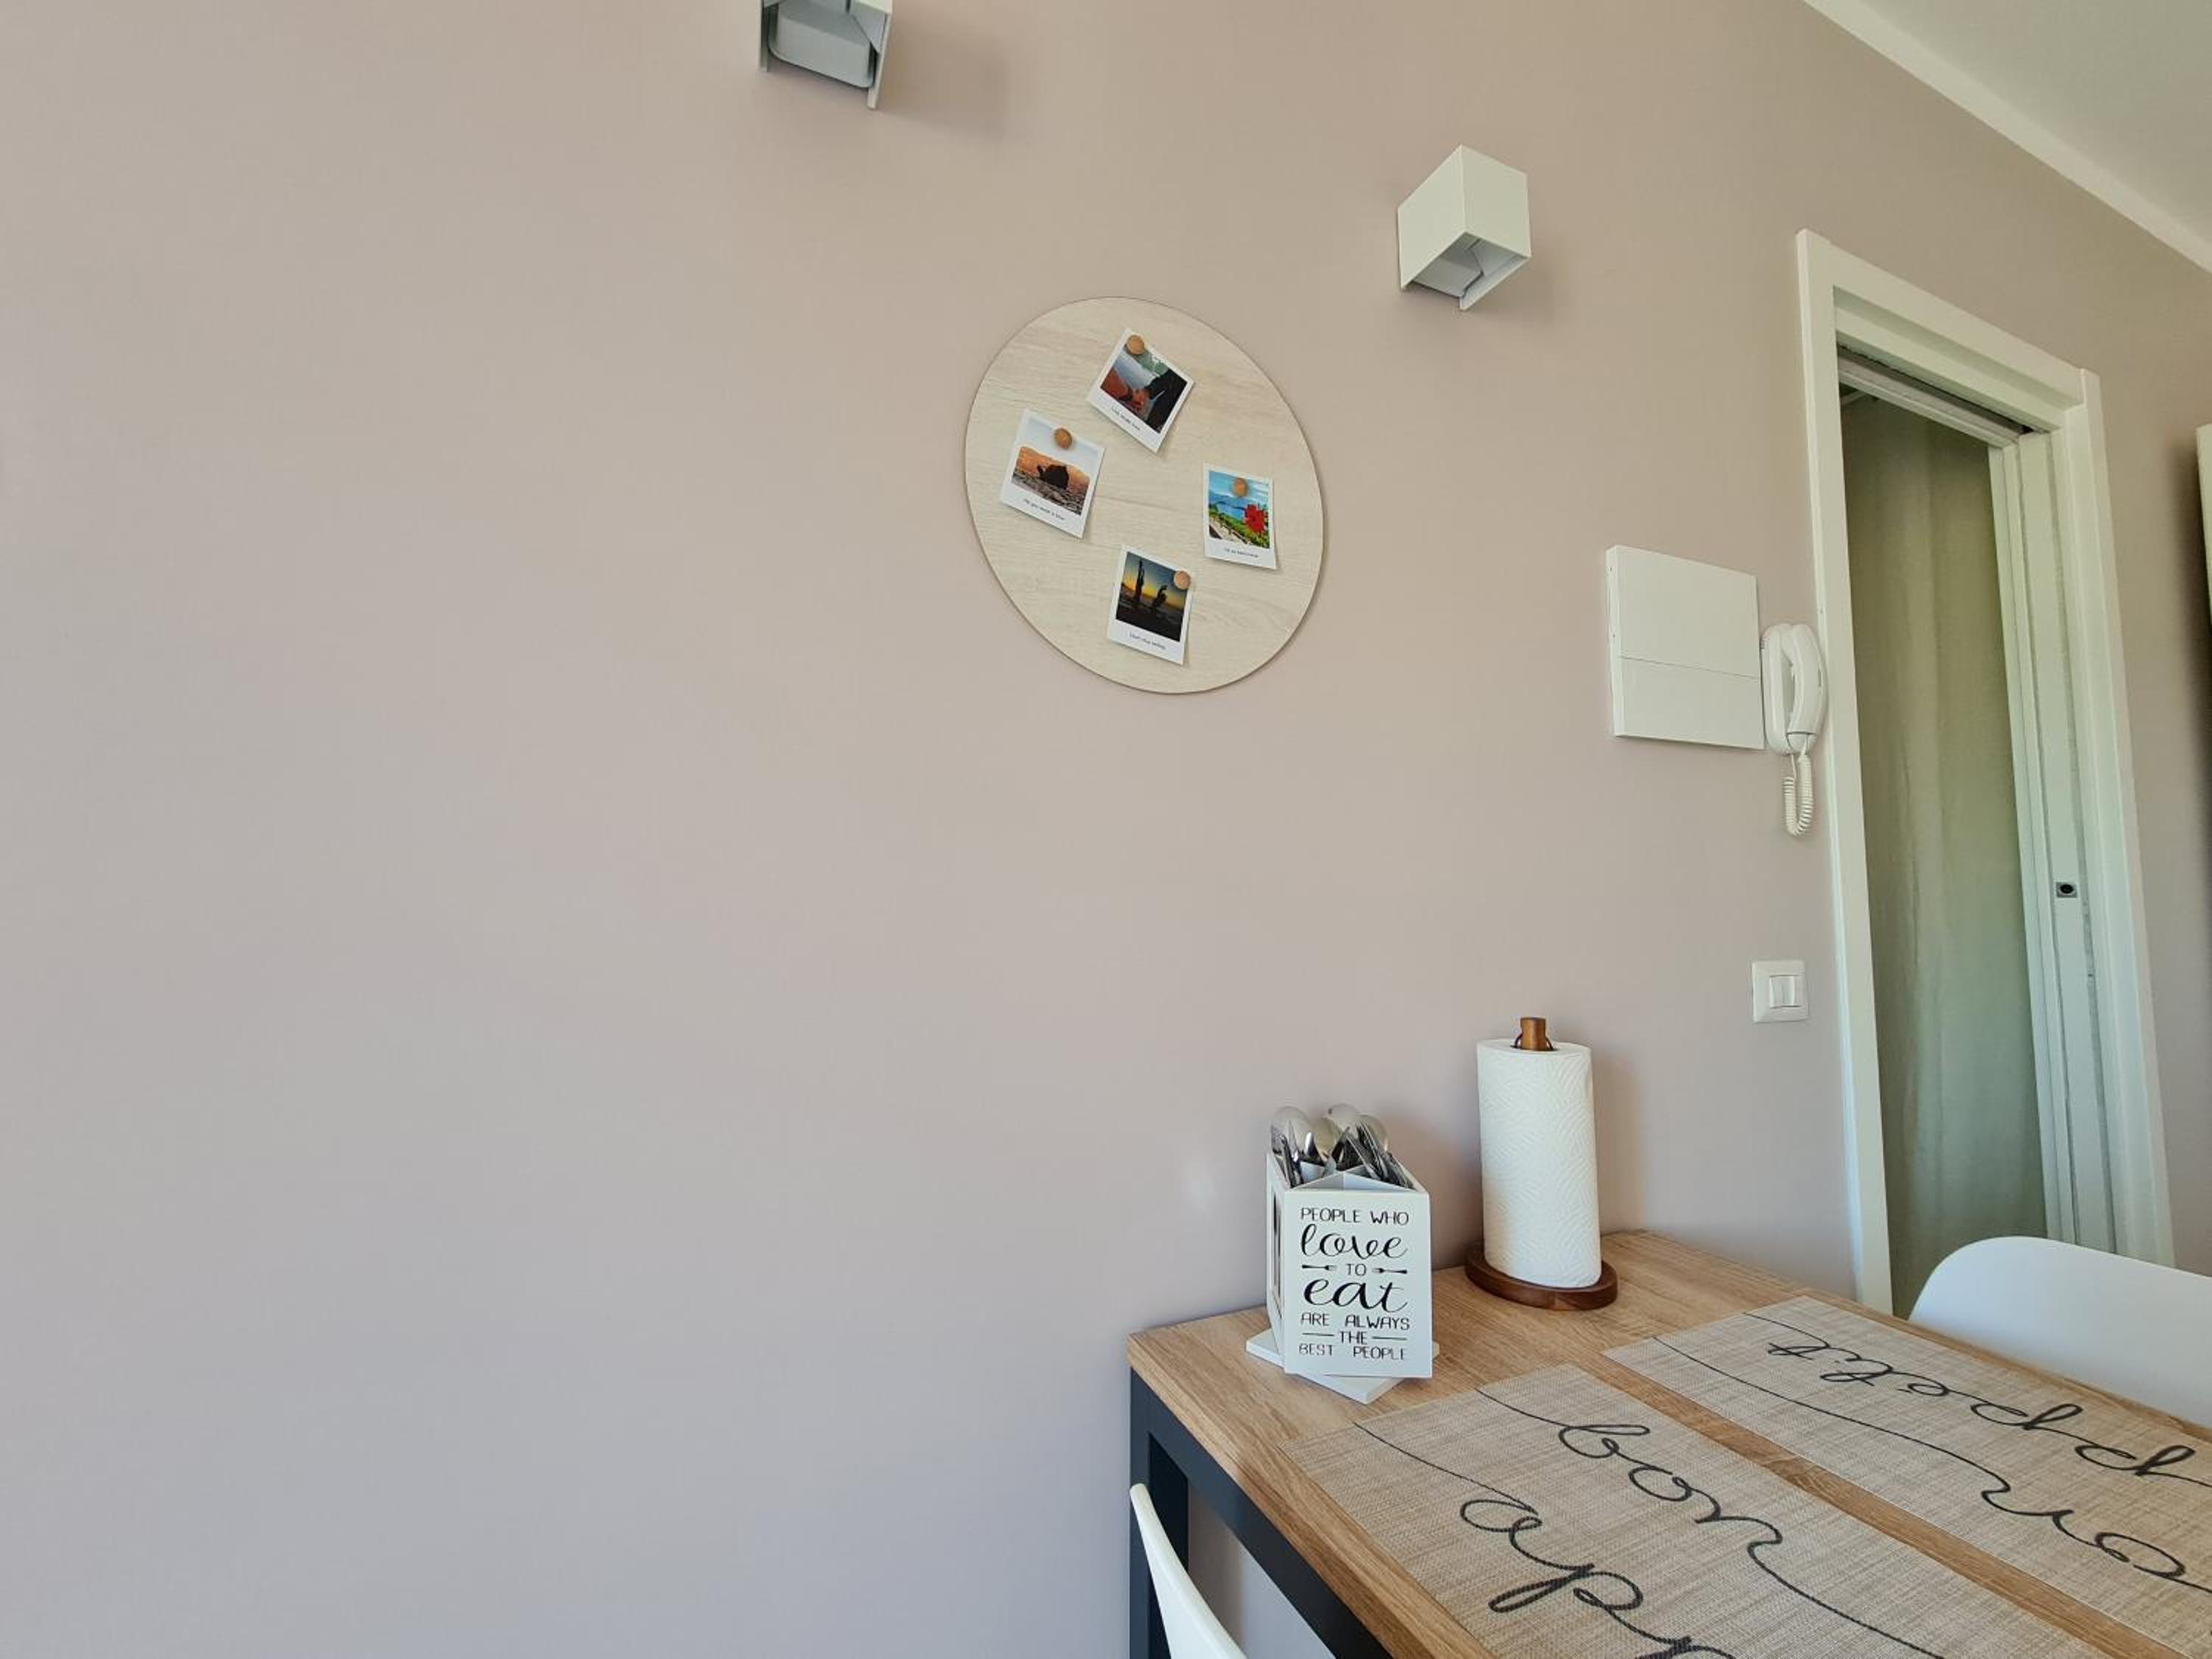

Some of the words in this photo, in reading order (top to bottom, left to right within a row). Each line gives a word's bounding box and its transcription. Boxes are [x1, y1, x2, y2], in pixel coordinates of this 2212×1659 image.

[1301, 1207, 1361, 1224] PEOPLE
[1370, 1211, 1410, 1225] WHO
[1300, 1223, 1408, 1260] love
[1346, 1263, 1367, 1276] TO
[1303, 1278, 1408, 1313] eat
[1301, 1312, 1330, 1326] ARE
[1344, 1314, 1411, 1331] ALWAYS
[1339, 1331, 1368, 1345] THE
[1298, 1344, 1334, 1357] BEST
[1352, 1346, 1407, 1361] PEOPLE
[1558, 1423, 1785, 1560] bon
[1981, 1474, 2211, 1587] on
